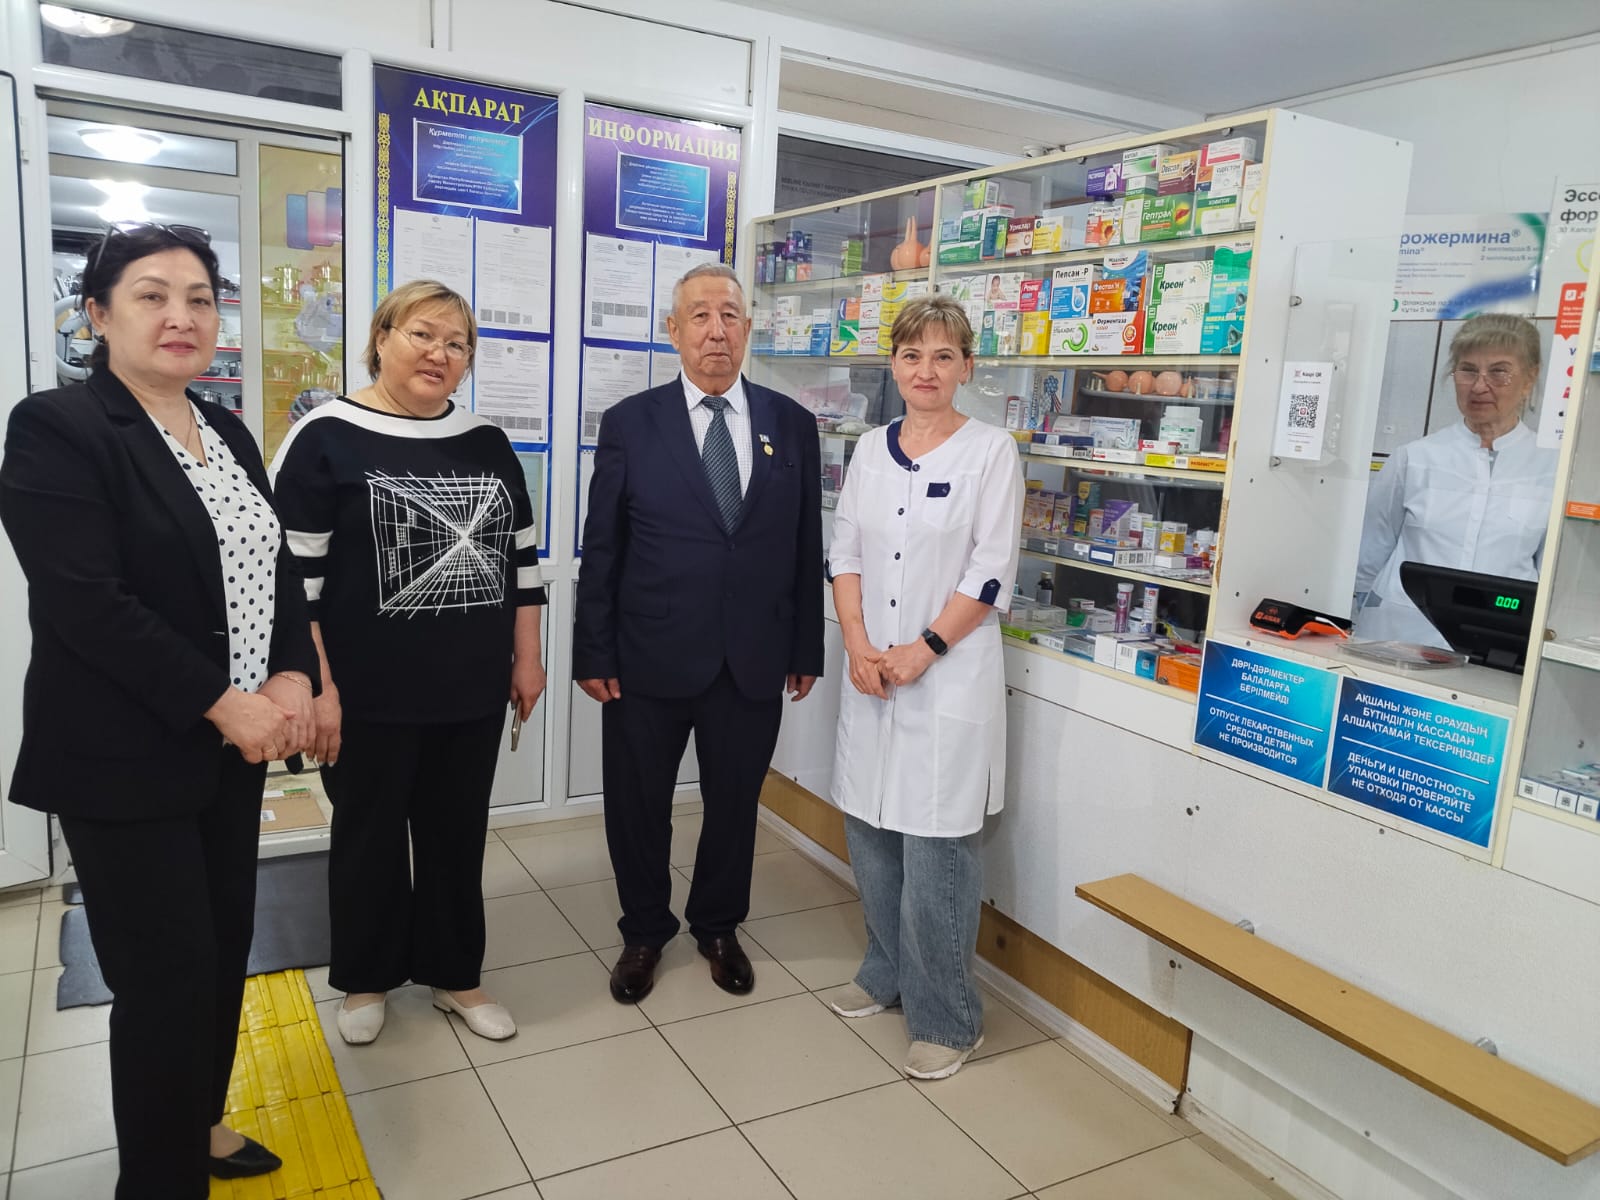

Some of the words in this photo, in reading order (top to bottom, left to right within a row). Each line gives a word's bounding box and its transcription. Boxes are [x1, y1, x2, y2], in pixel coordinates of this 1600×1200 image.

[413, 87, 525, 124] АҚПАРАТ
[588, 116, 740, 161] ИНФОРМАЦИЯ
[1142, 210, 1172, 221] Гептрал
[1160, 280, 1184, 292] Креон
[1152, 322, 1177, 334] Креон
[1232, 658, 1305, 684] ДӘРІ-ДӘРІМЕКТЕР
[1241, 672, 1290, 693] БАЛАЛАРҒА
[1240, 683, 1289, 704] БЕРІЛМЕЙДІ
[1210, 707, 1243, 723] ОТПУСК
[1241, 717, 1314, 748] ЛЕКАРСТВЕННЫХ
[1355, 693, 1400, 712] АҚШАНЫ
[1402, 705, 1432, 720] ЖӘНЕ
[1435, 714, 1488, 739] ОРАУДЫҢ
[1363, 707, 1414, 728] БҮТІНДІГІН
[1417, 721, 1475, 746] КАССАДАН
[1219, 732, 1230, 742] НЕ
[1231, 737, 1297, 765] ПРОИЗВОДИТСЯ
[1226, 724, 1262, 742] СРЕДСТВ
[1264, 736, 1293, 752] ДЕТЯМ
[1343, 714, 1411, 741] АЛШАҚТАМАЙ
[1414, 734, 1495, 764] ТЕКСЕРІҢІЗДЕР
[1348, 752, 1386, 771] ДЕНЬГИ
[1398, 767, 1475, 801] ЦЕЛОСТНОСТЬ
[1348, 765, 1399, 788] УПАКОВКИ
[1402, 779, 1471, 813] ПРОВЕРЯЙТЕ
[1352, 778, 1364, 789] НЕ
[1367, 783, 1406, 804] ОТХОДЯ
[1409, 797, 1422, 808] ОТ
[1425, 803, 1463, 823] КАССЫ
